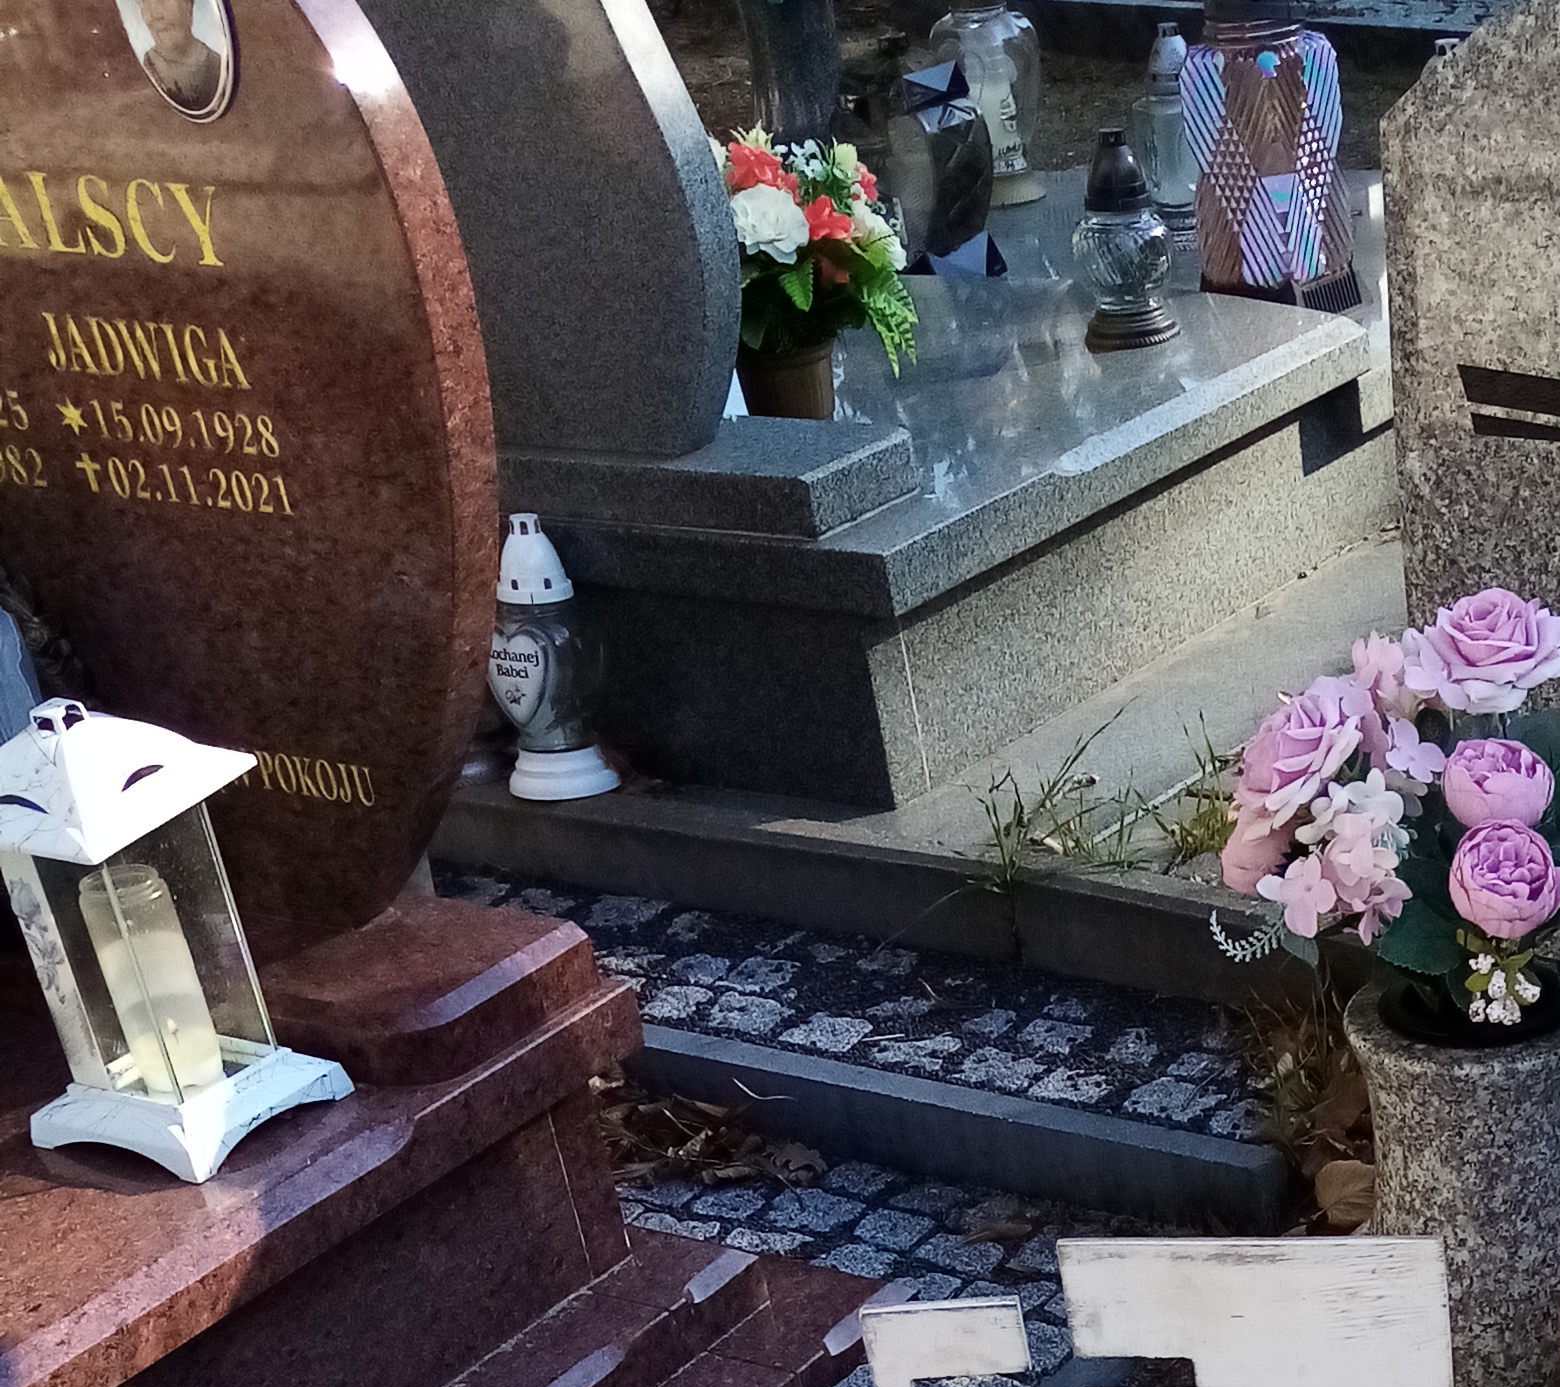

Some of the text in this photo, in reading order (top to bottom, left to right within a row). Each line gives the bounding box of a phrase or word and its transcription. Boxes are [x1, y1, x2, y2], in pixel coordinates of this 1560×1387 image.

[41, 312, 251, 389] JADWIGA
[88, 399, 280, 458] 15.09.1928
[107, 456, 295, 516] 02.11.2021
[496, 663, 530, 679] Babci
[256, 751, 376, 807] POKOJU
